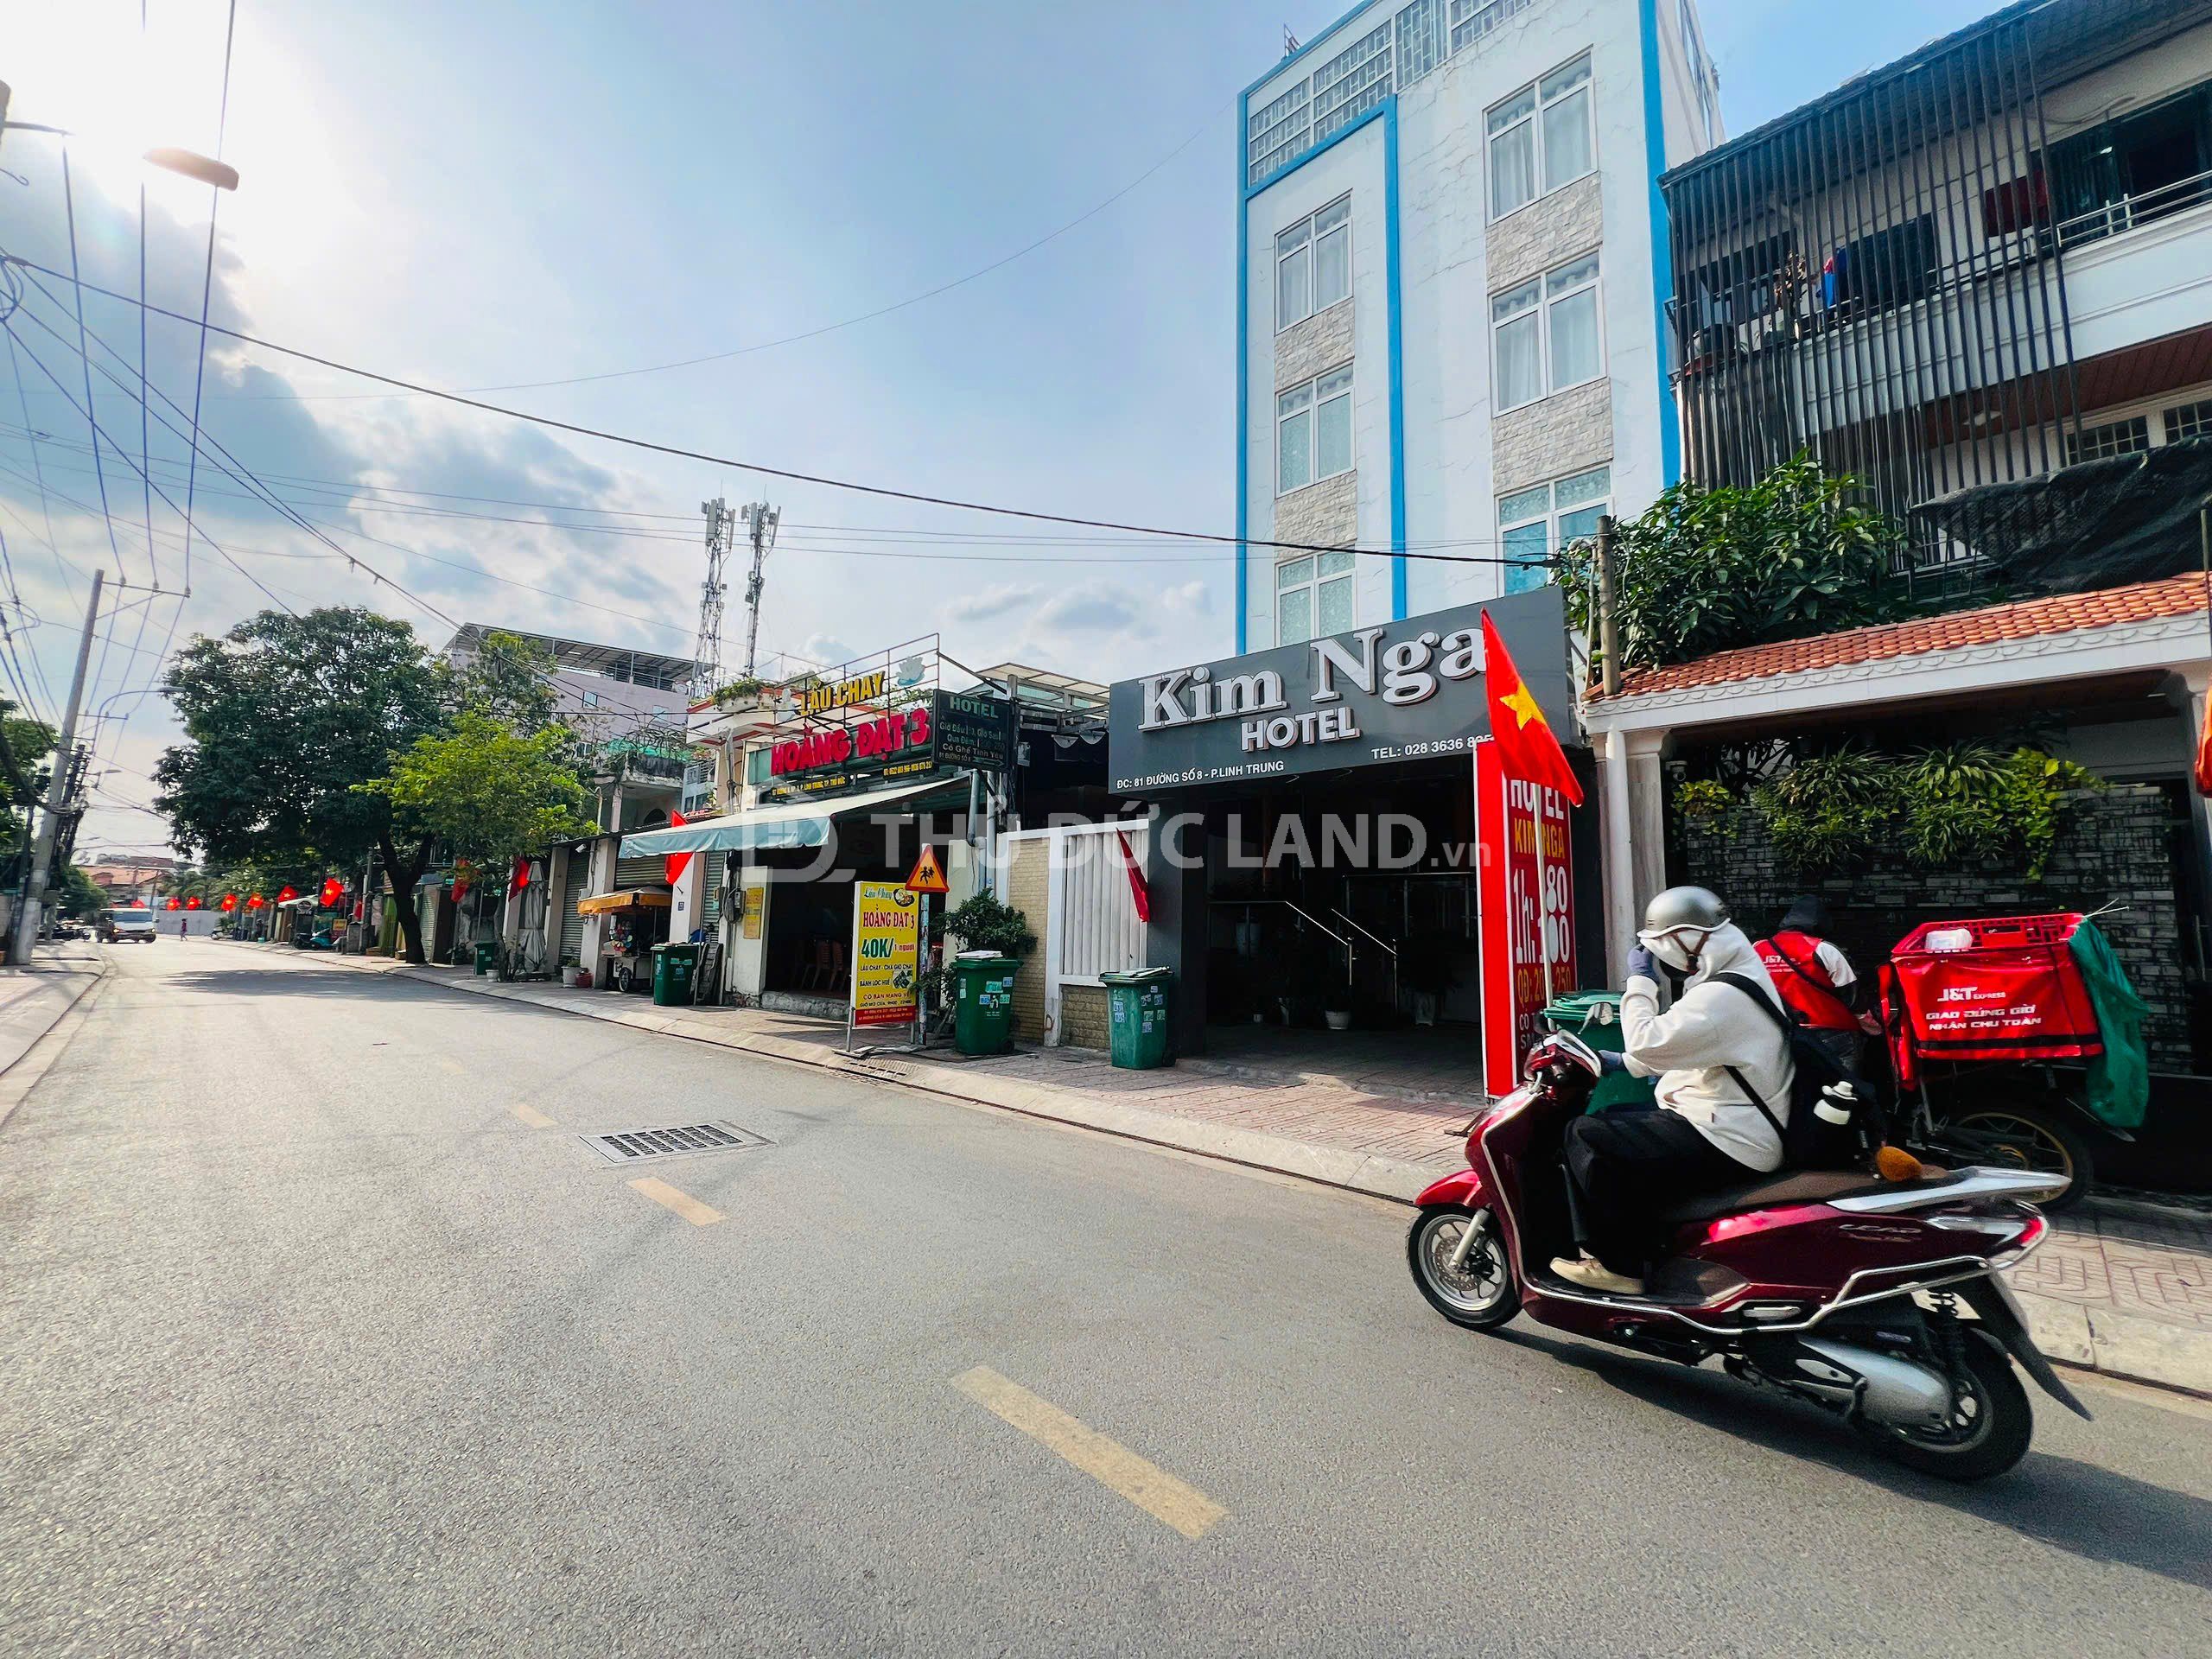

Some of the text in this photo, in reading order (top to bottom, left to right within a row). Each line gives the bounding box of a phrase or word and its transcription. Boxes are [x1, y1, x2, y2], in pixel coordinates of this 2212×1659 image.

[836, 671, 885, 707] CHAY
[1137, 627, 1487, 731] Kim Nga
[950, 696, 999, 718] HOTEL
[771, 722, 852, 776] HOÀNG
[910, 708, 931, 746] 3
[1241, 706, 1361, 752] HOTEL
[1371, 747, 1402, 759] TEL:
[1404, 741, 1427, 756] 028
[1431, 738, 1464, 753] 3636
[1116, 779, 1132, 790] ĐC:
[1134, 777, 1144, 787] 81
[1146, 773, 1179, 785] ĐƯỜNG
[1181, 767, 1196, 782] SỐ
[1196, 770, 1203, 780] 8
[1211, 765, 1243, 779] P.LINH
[1246, 760, 1284, 775] TRUNG
[1510, 779, 1564, 820] HOEL
[1937, 987, 1978, 1002] J&T
[1926, 1011, 1960, 1020] GIAO
[2010, 1004, 2037, 1015] GIỜ
[2002, 1016, 2041, 1026] TOÀN
